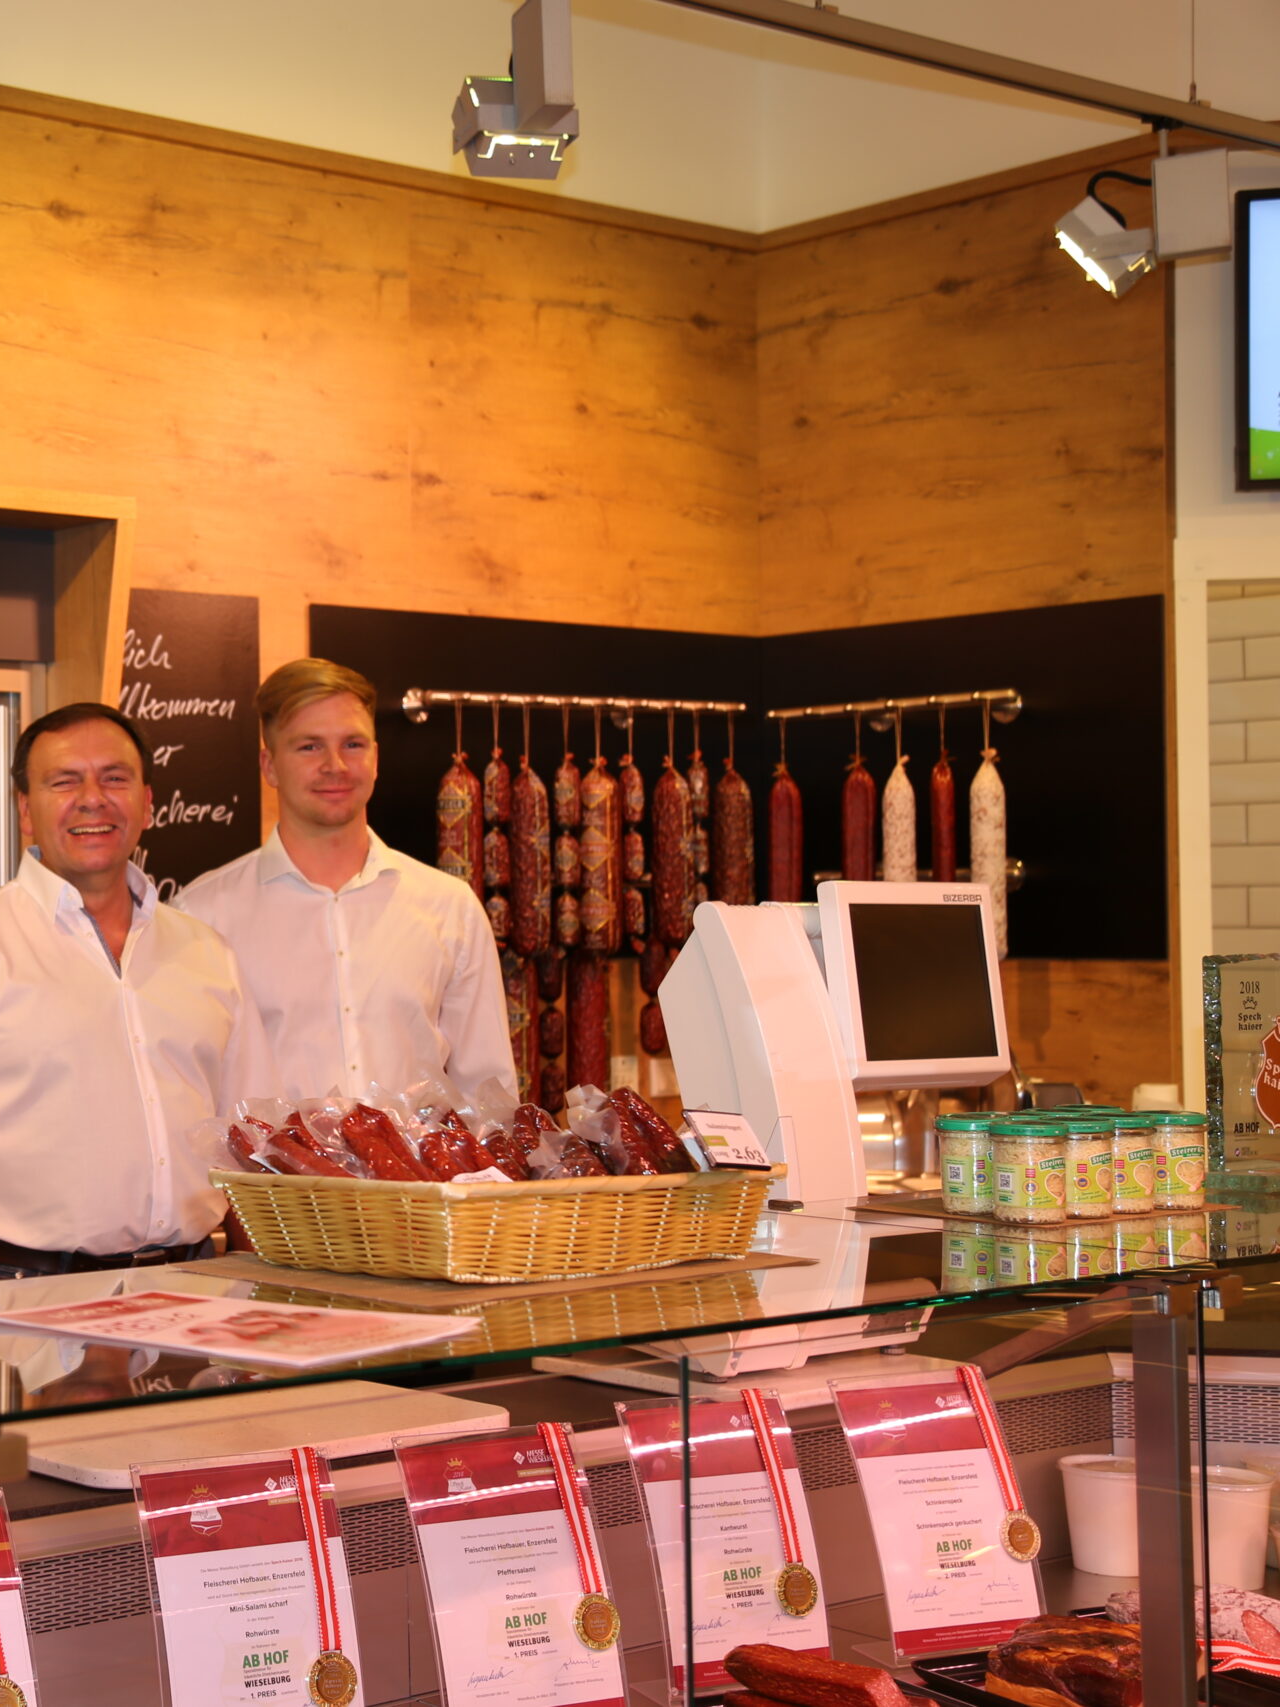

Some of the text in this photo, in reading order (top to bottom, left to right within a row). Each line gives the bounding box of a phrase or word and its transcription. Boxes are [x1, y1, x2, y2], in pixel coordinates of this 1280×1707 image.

[943, 894, 983, 903] BIZERBA
[1239, 981, 1261, 994] 2018
[1233, 1121, 1260, 1134] AB HOF
[936, 1538, 973, 1553] AB HOF
[939, 1560, 976, 1569] WIESELBURG
[203, 1578, 239, 1588] Fleischerei
[272, 1570, 306, 1580] Enzersfeld
[723, 1566, 762, 1582] AB HOF
[725, 1589, 765, 1600] WIESELBURG
[229, 1600, 289, 1613] Mini-Salami scharf
[505, 1612, 548, 1629] AB HOF
[507, 1636, 551, 1648] WIESELBURG
[242, 1650, 289, 1668] AB HOF
[520, 1649, 538, 1657] PREIS
[244, 1675, 292, 1688] WIESELBURG
[257, 1690, 277, 1699] PREIS
